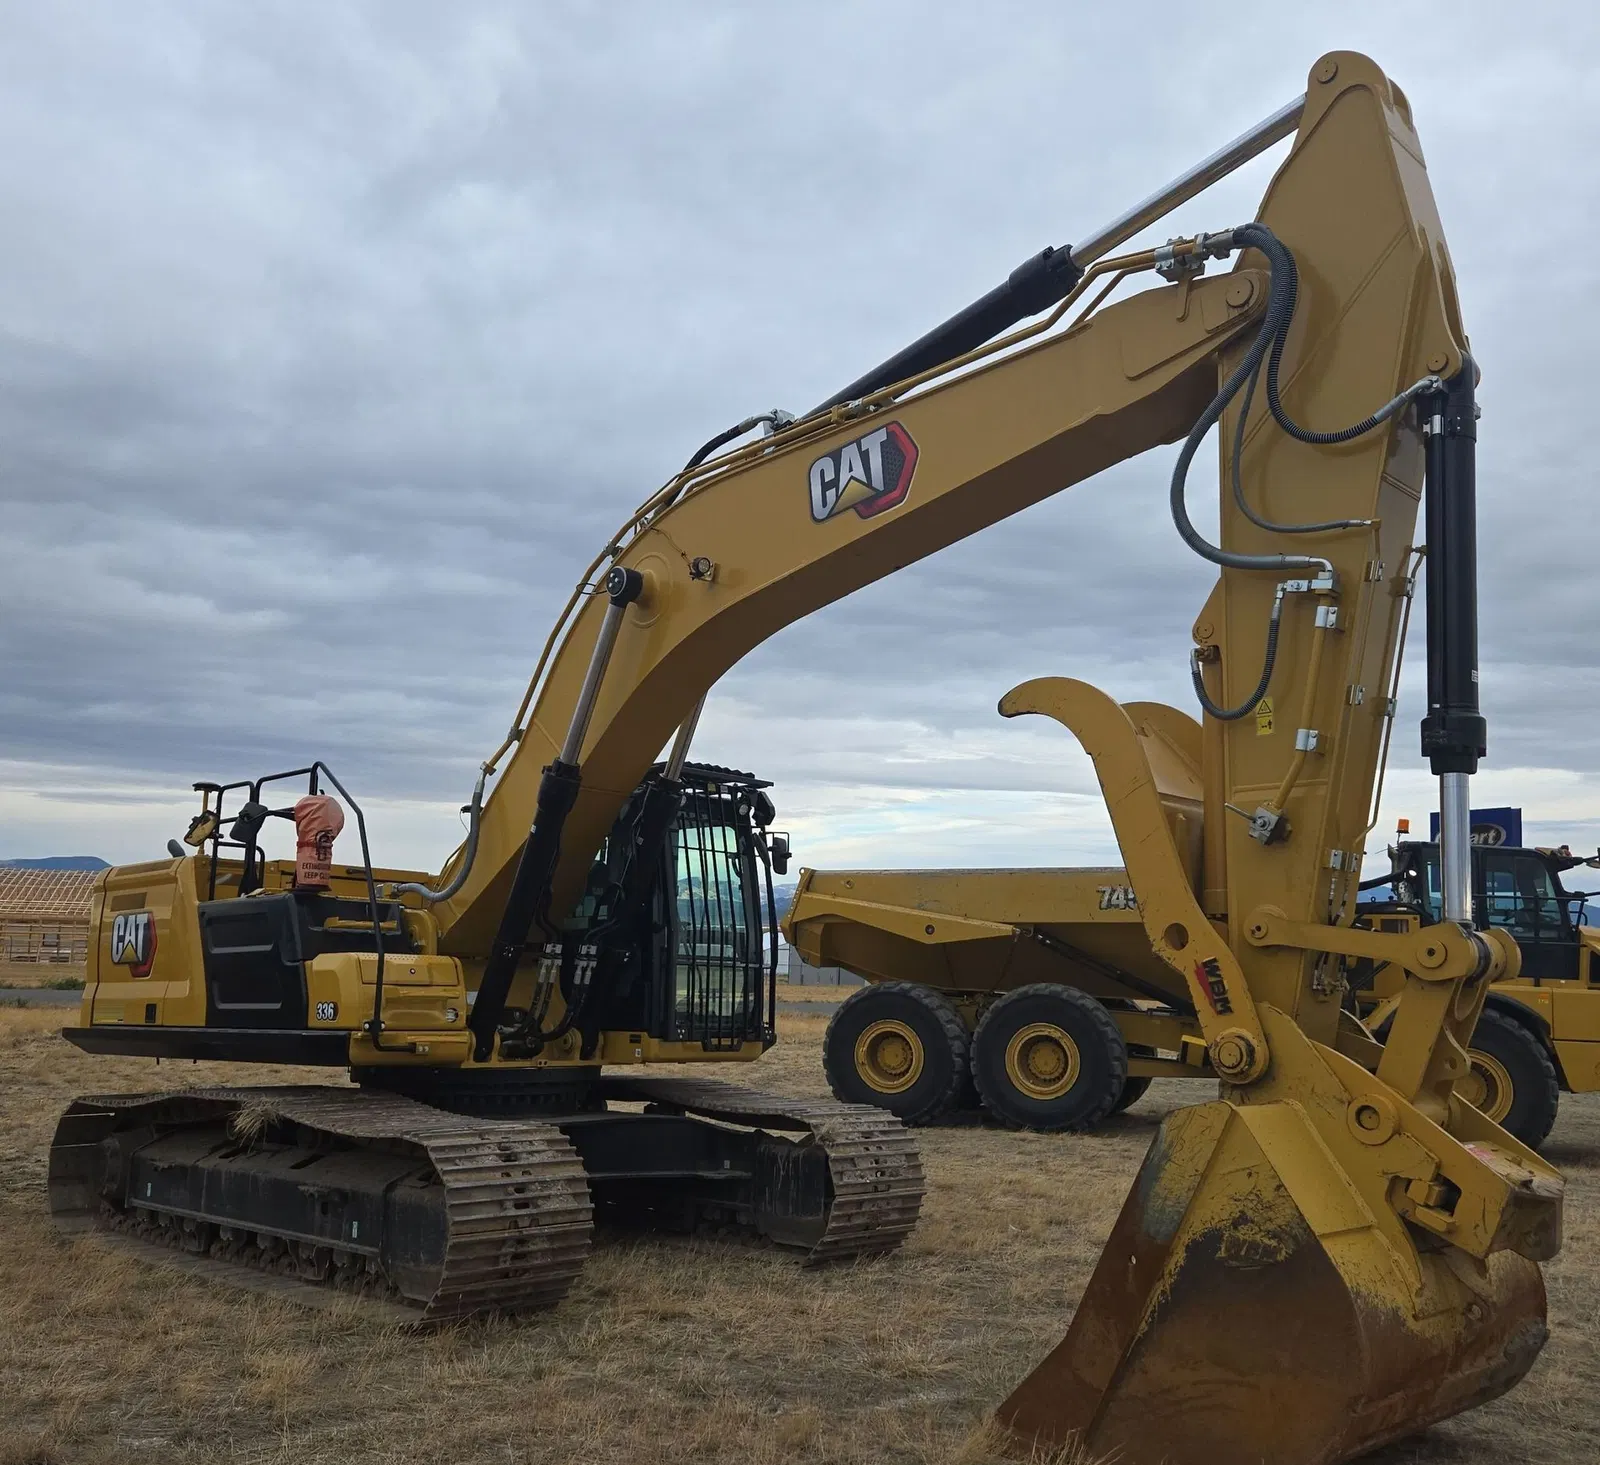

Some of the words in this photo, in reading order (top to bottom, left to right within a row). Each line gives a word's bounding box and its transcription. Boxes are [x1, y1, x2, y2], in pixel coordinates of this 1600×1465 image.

[810, 427, 888, 520] CAT
[112, 912, 149, 963] CAT
[316, 1002, 335, 1020] 336
